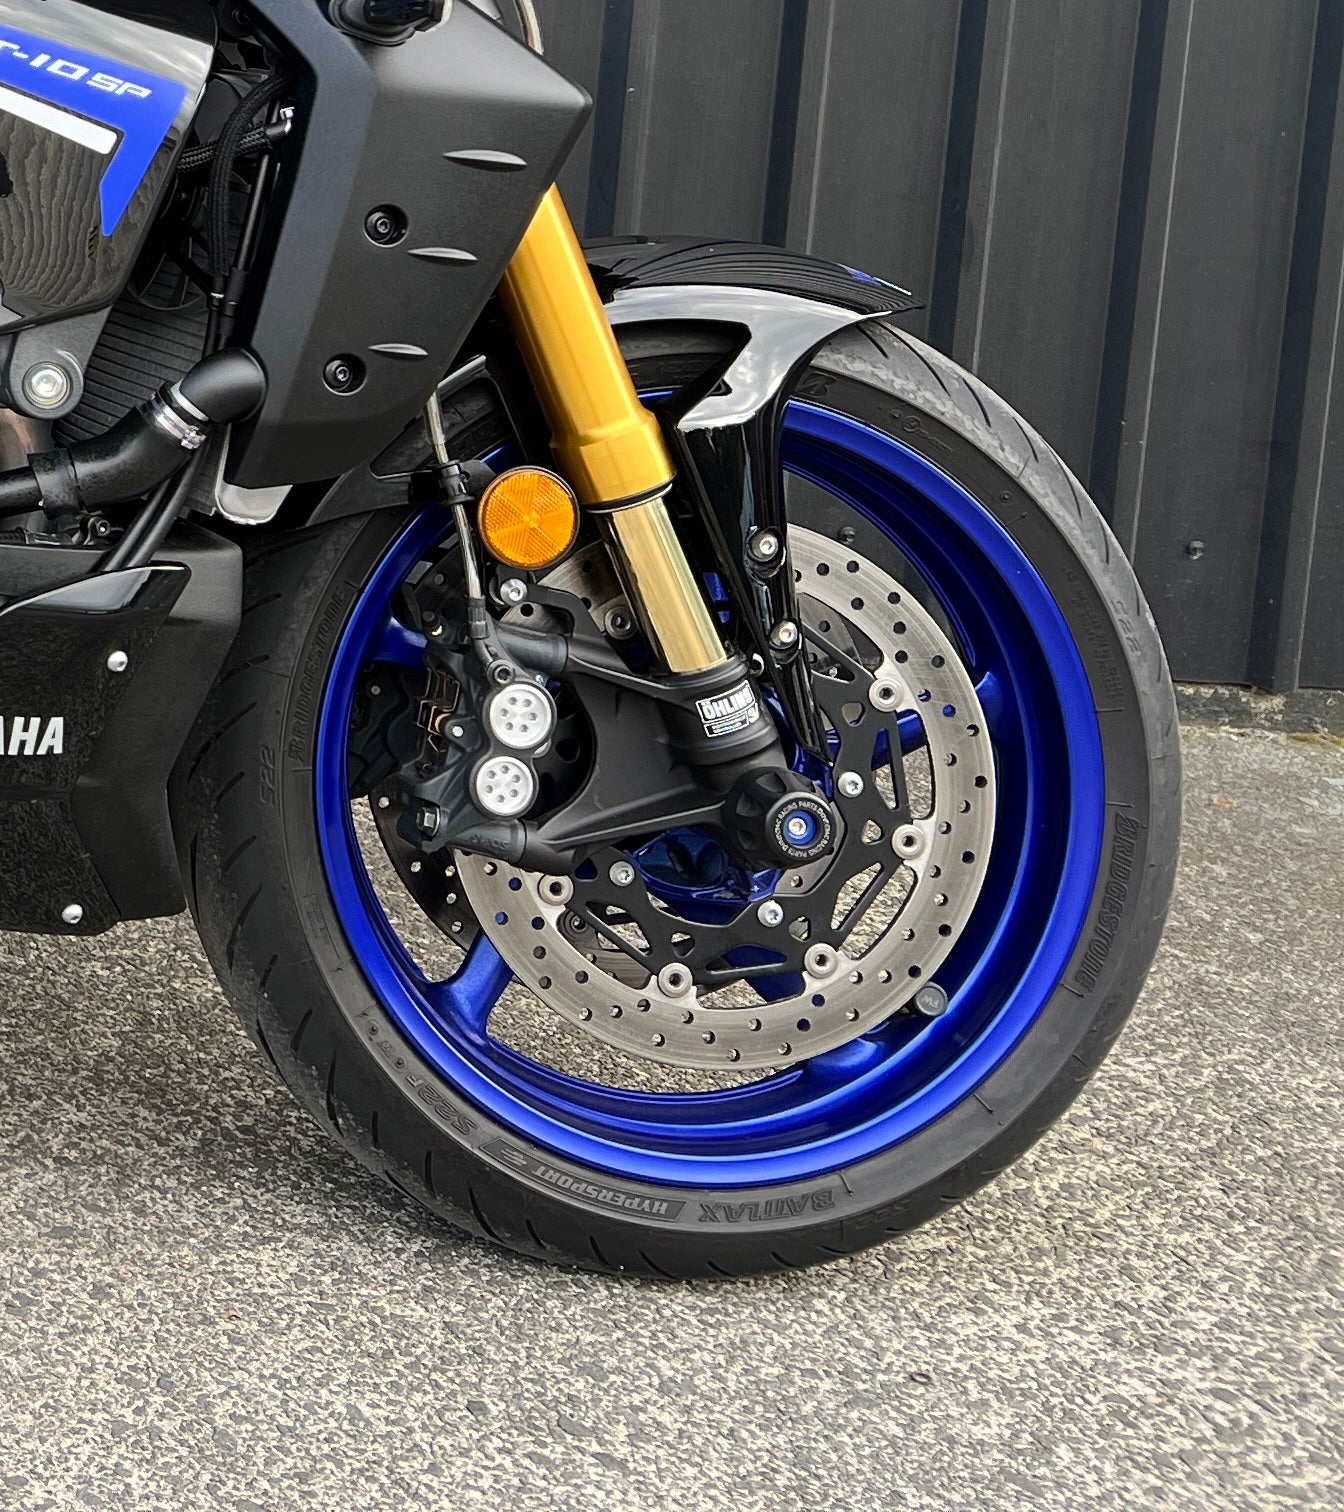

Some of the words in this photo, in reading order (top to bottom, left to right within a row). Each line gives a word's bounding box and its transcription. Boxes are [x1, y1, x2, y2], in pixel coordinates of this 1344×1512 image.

[288, 591, 347, 763] BRIDGESTONE
[1074, 810, 1140, 992] BRIDGESTONE
[532, 1164, 670, 1216] HYPERSPORT
[699, 1190, 838, 1223] BATTLAX
